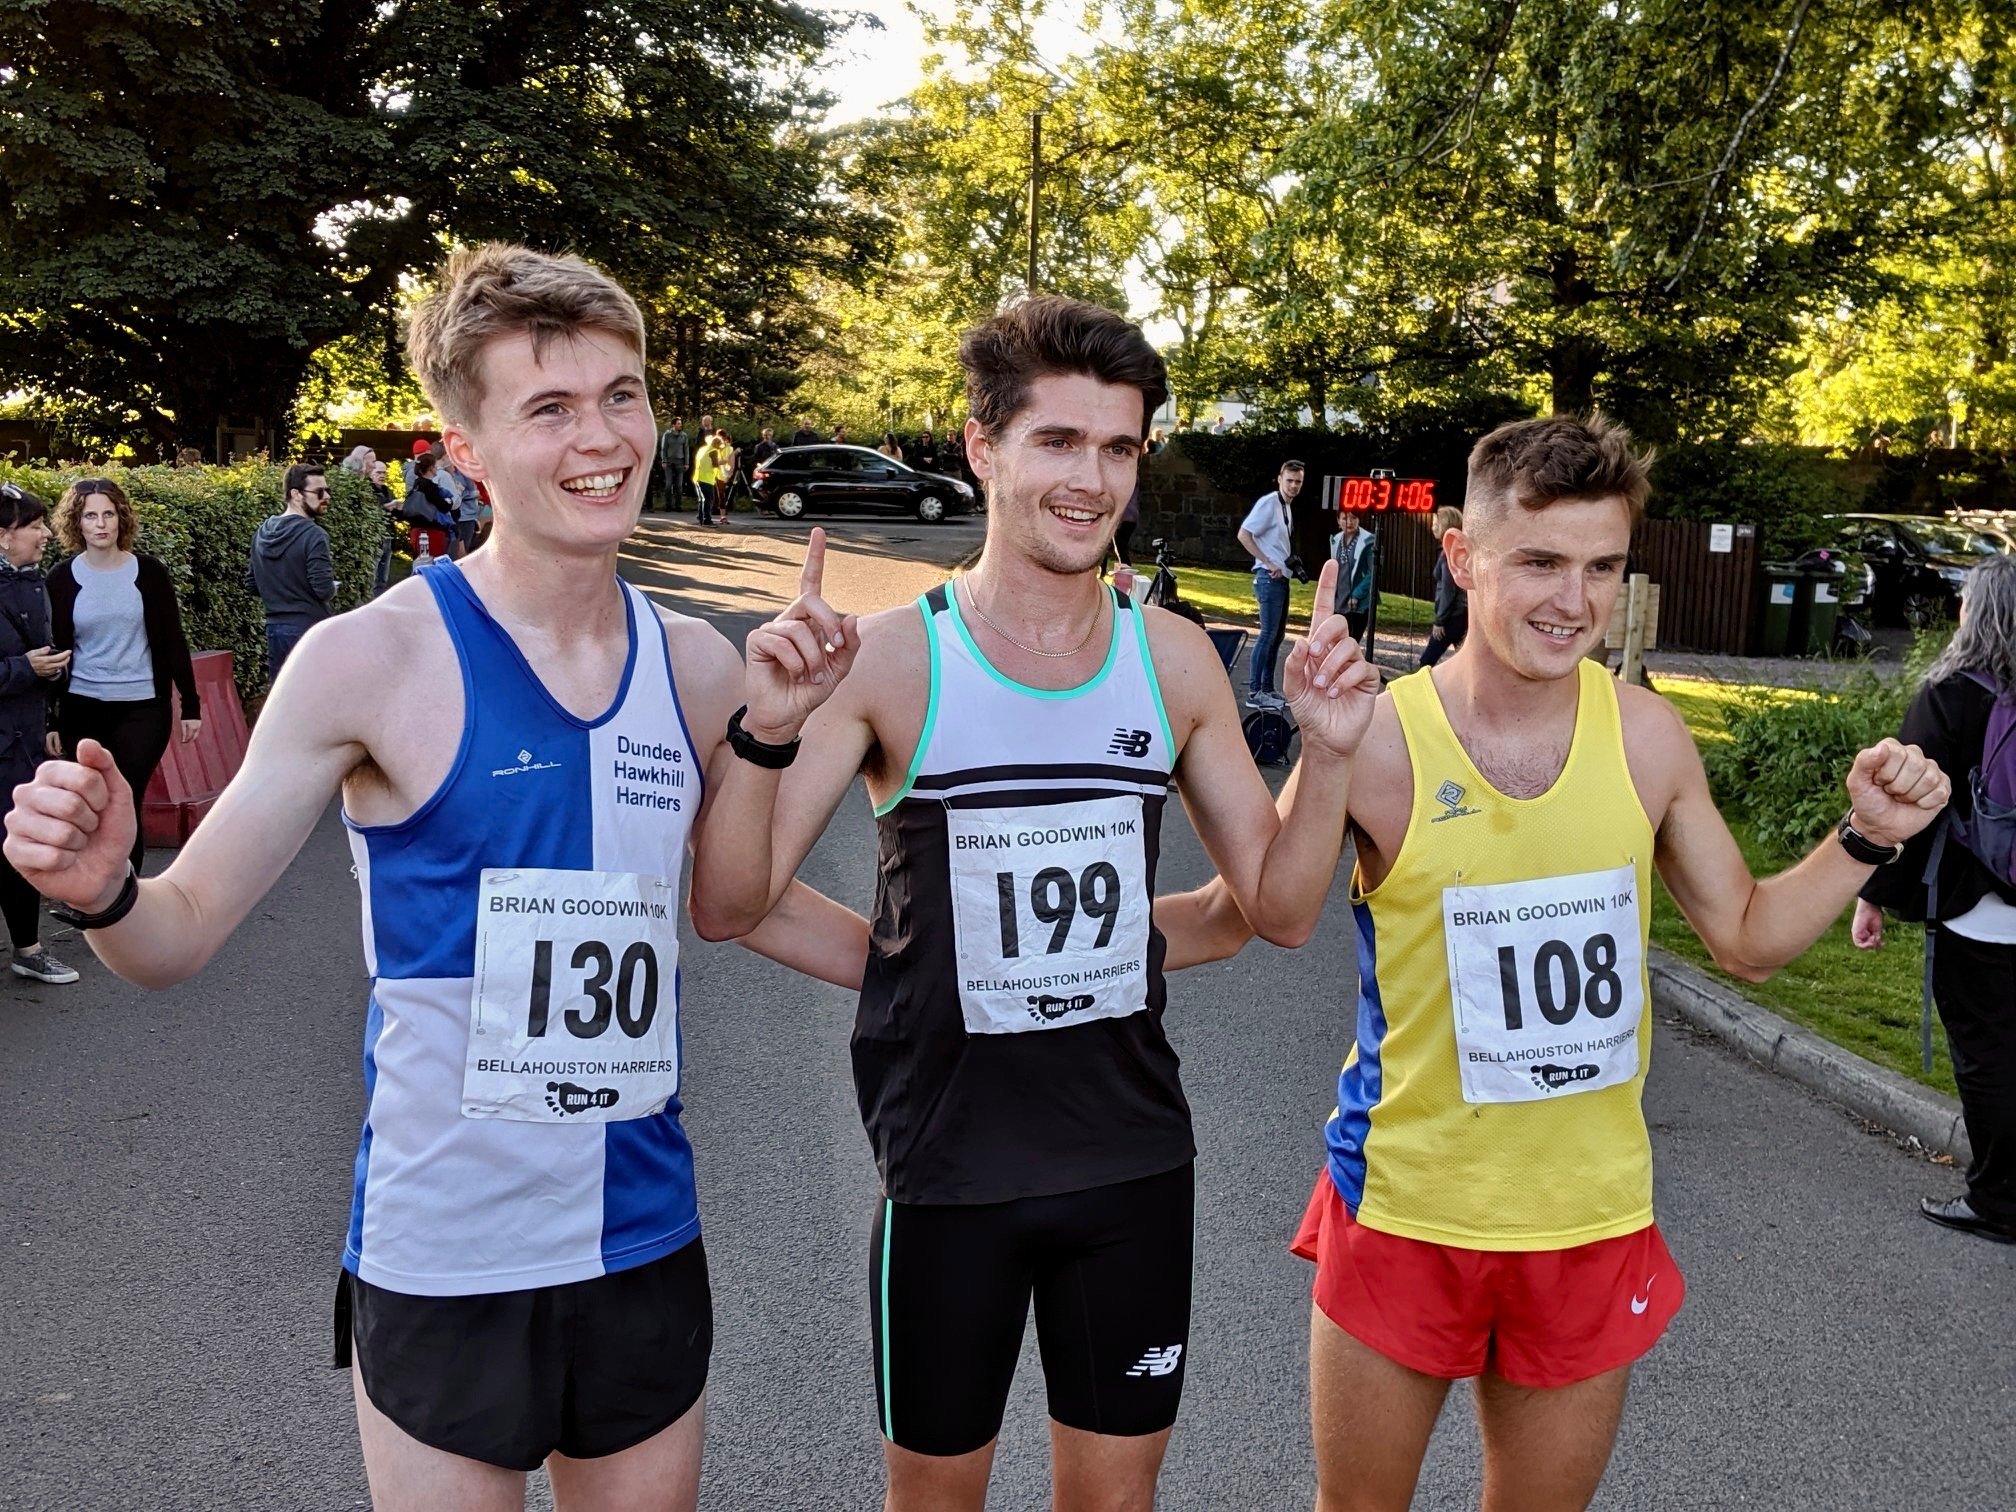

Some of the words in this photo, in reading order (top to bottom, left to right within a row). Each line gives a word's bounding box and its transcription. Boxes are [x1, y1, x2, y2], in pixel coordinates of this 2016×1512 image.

[1343, 480, 1435, 510] 00:31:06
[617, 735, 682, 763] Dundee
[492, 761, 562, 778] RONHILL
[614, 760, 684, 788] Hawkhill
[616, 786, 681, 812] Harriers
[955, 834, 1011, 850] BRIAN
[1017, 824, 1106, 847] GOODWIN
[1110, 819, 1136, 837] 10K
[489, 896, 555, 914] BRIAN
[562, 899, 648, 917] GOODWIN
[649, 904, 668, 920] 10K
[996, 861, 1121, 959] 199
[1453, 909, 1511, 926] BRIAN
[1516, 897, 1606, 922] GOODWIN
[1610, 890, 1633, 909] 10K
[527, 940, 658, 1039] 130
[966, 972, 1080, 991] BELLAHOUSTON
[1084, 960, 1140, 983] HARRIERS
[1497, 933, 1623, 1031] 108
[1045, 1001, 1065, 1013] RUN
[1065, 1000, 1073, 1011] 4
[1074, 998, 1084, 1009] IT
[1468, 1043, 1583, 1063] BELLAHOUSTON
[1586, 1026, 1636, 1052] HARRIERS
[477, 1059, 607, 1075] BELLAHOUSTON
[611, 1060, 672, 1074] HARRIERS
[1549, 1070, 1569, 1082] RUN
[1570, 1069, 1577, 1079] 4
[1579, 1068, 1589, 1078] IT
[566, 1093, 588, 1106] RUN
[590, 1093, 598, 1105] 4
[599, 1092, 610, 1105] IT
